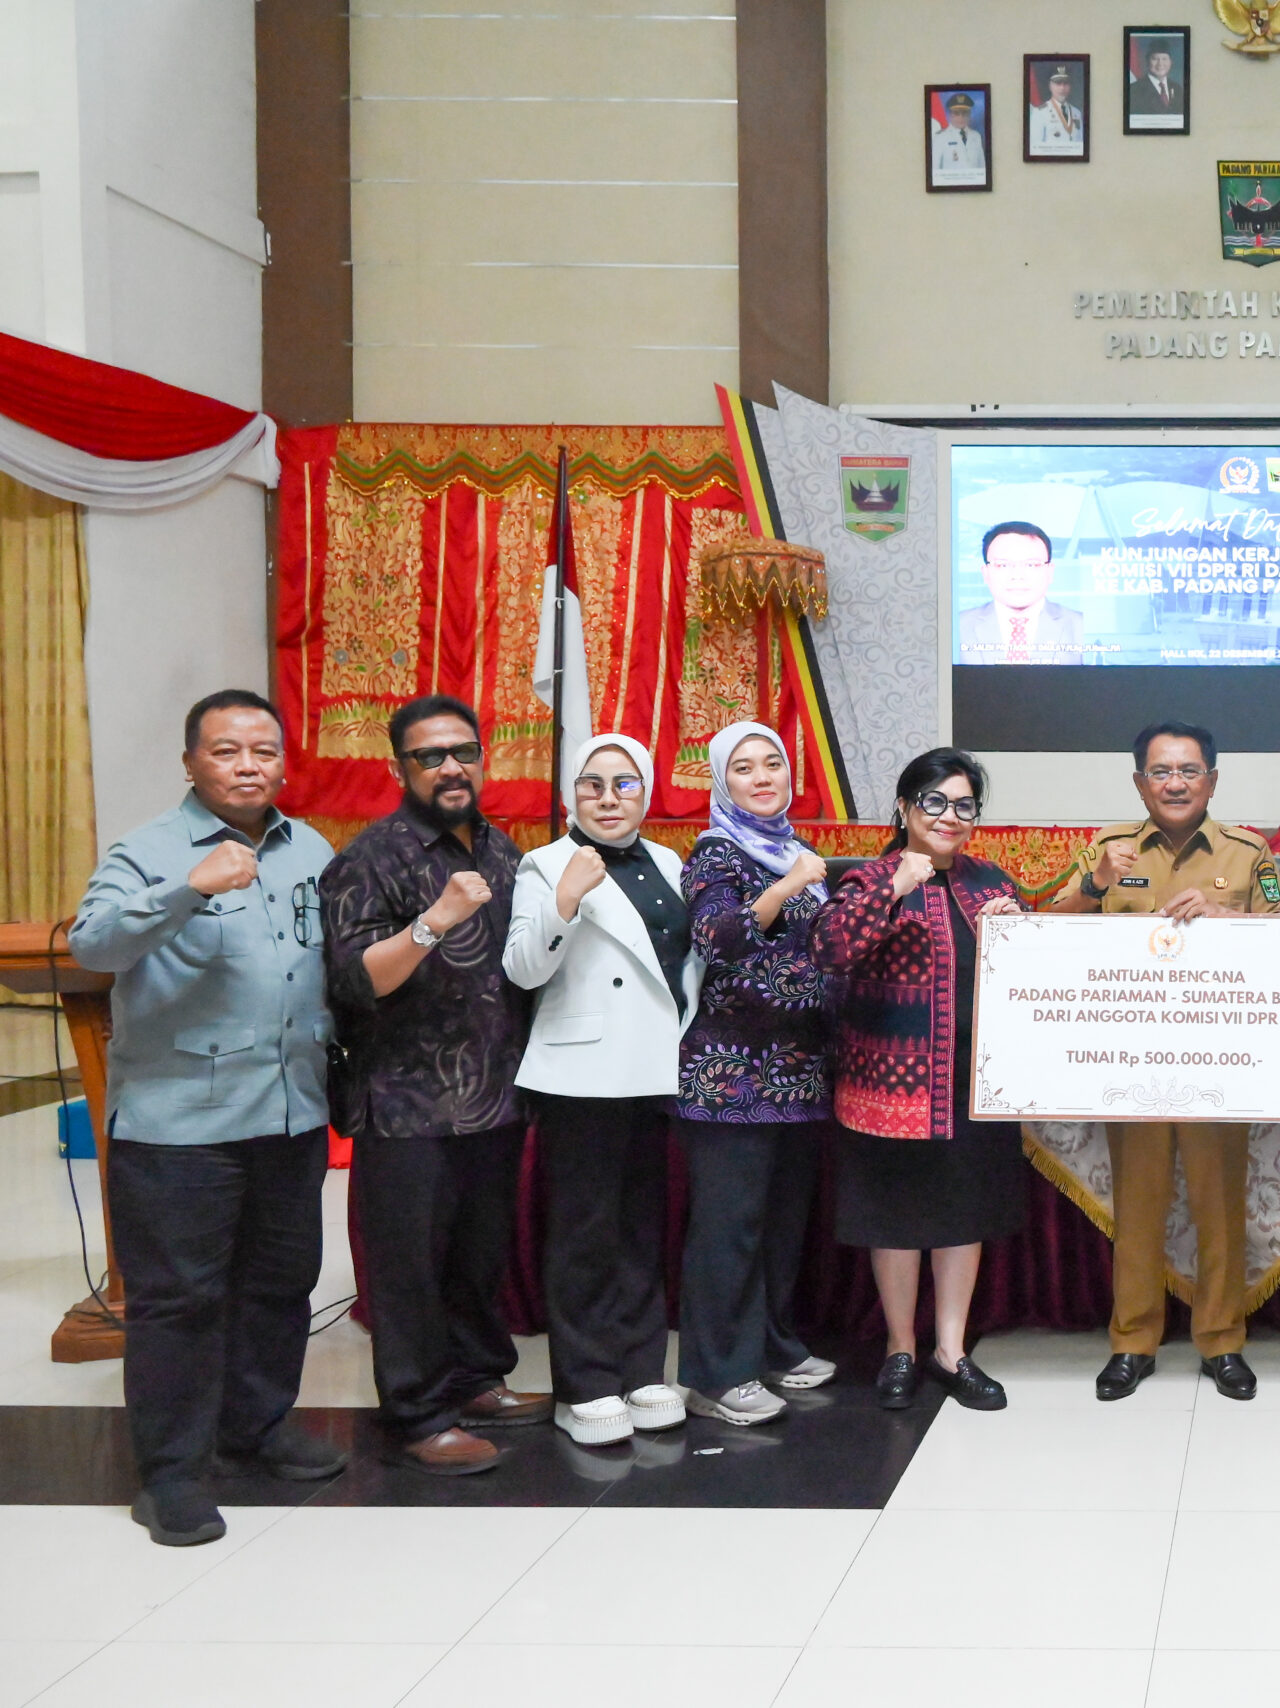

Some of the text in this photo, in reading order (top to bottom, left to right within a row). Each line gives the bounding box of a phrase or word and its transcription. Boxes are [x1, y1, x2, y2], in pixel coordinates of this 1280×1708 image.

[1221, 163, 1252, 175] PADANG
[1074, 290, 1259, 319] PEMERINTAH
[1105, 330, 1228, 361] PADANG
[1131, 507, 1242, 541] Selamat
[1101, 547, 1227, 562] KUNJUNGAN
[1092, 563, 1162, 577] KOMISI
[1167, 563, 1192, 577] VII
[1198, 563, 1238, 577] DPR
[1241, 563, 1260, 577] RI
[1094, 579, 1119, 593] KE
[1124, 579, 1169, 593] KAB.
[1174, 578, 1259, 593] PADANG
[1160, 649, 1186, 658] HALL
[1223, 649, 1276, 658] DESEMBER
[1087, 968, 1246, 983] BANTUAN BENCANA
[1008, 988, 1077, 1002] PADANG
[1081, 989, 1167, 1003] PARIAMAN
[1181, 990, 1268, 1004] SUMATERA
[1033, 1009, 1071, 1022] DARI
[1075, 1009, 1157, 1023] ANGGOTA
[1161, 1010, 1219, 1024] KOMISI
[1222, 1011, 1242, 1024] VII
[1247, 1012, 1279, 1025] DPR
[1066, 1050, 1263, 1068] TUNAI Rp 500.000.000,-
